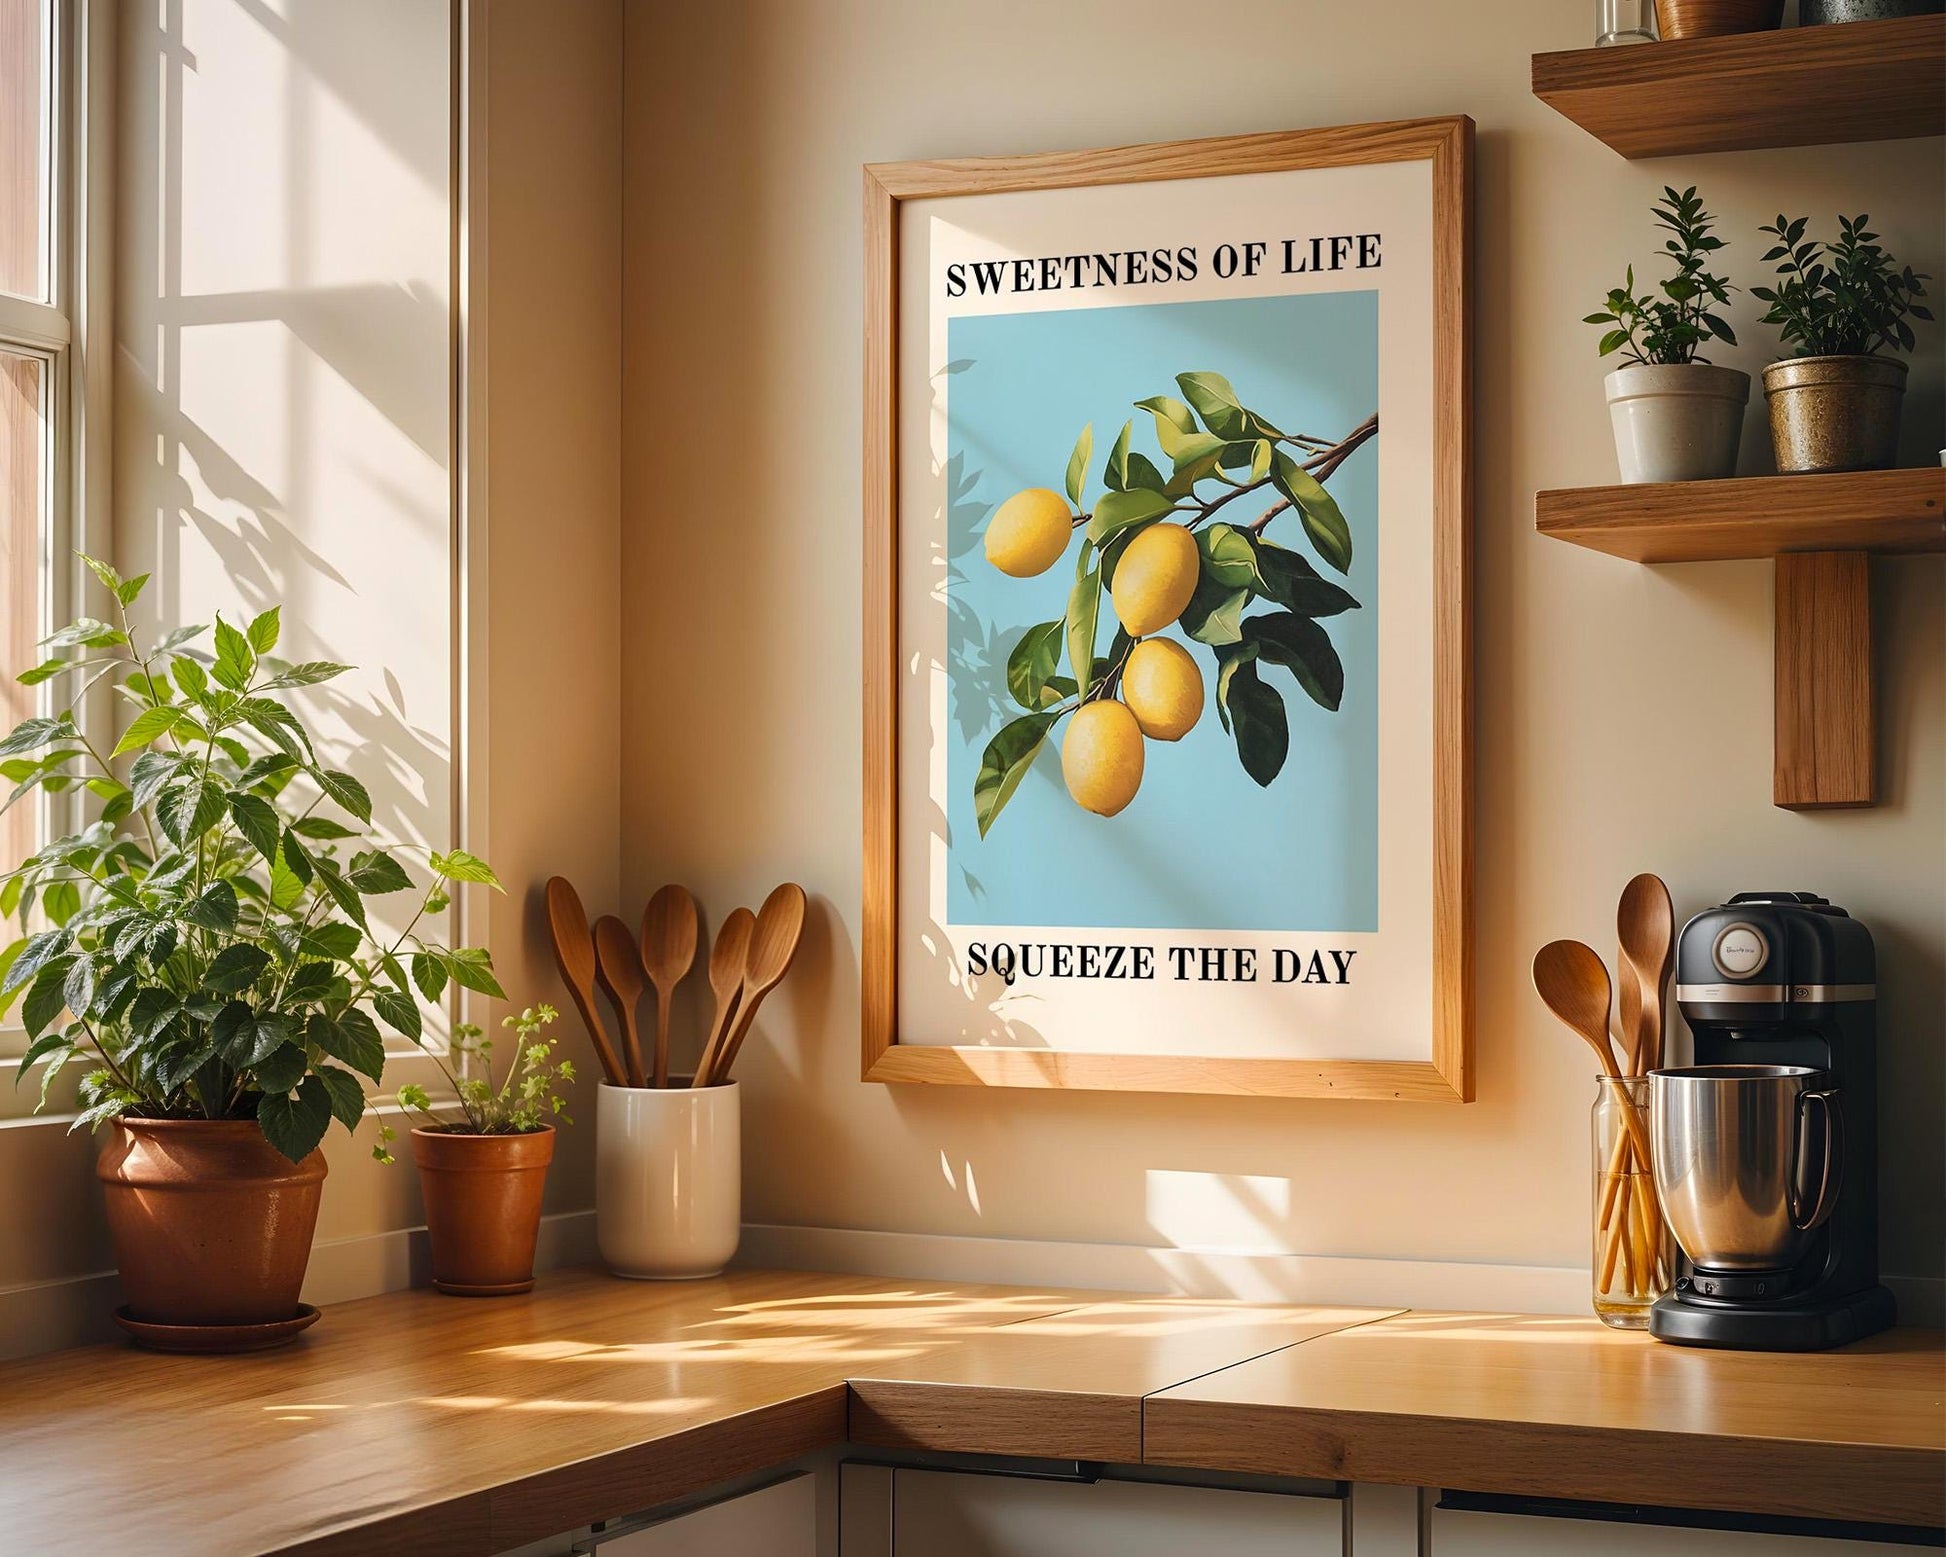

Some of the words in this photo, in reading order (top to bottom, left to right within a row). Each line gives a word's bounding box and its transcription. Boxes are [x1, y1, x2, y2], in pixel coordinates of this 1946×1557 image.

[947, 246, 1198, 297] SWEETNESS
[1212, 242, 1267, 279] OF
[1281, 233, 1382, 274] LIFE
[967, 942, 1154, 986] SQUEEZE
[1168, 947, 1257, 982] THE
[1271, 949, 1358, 985] DAY
